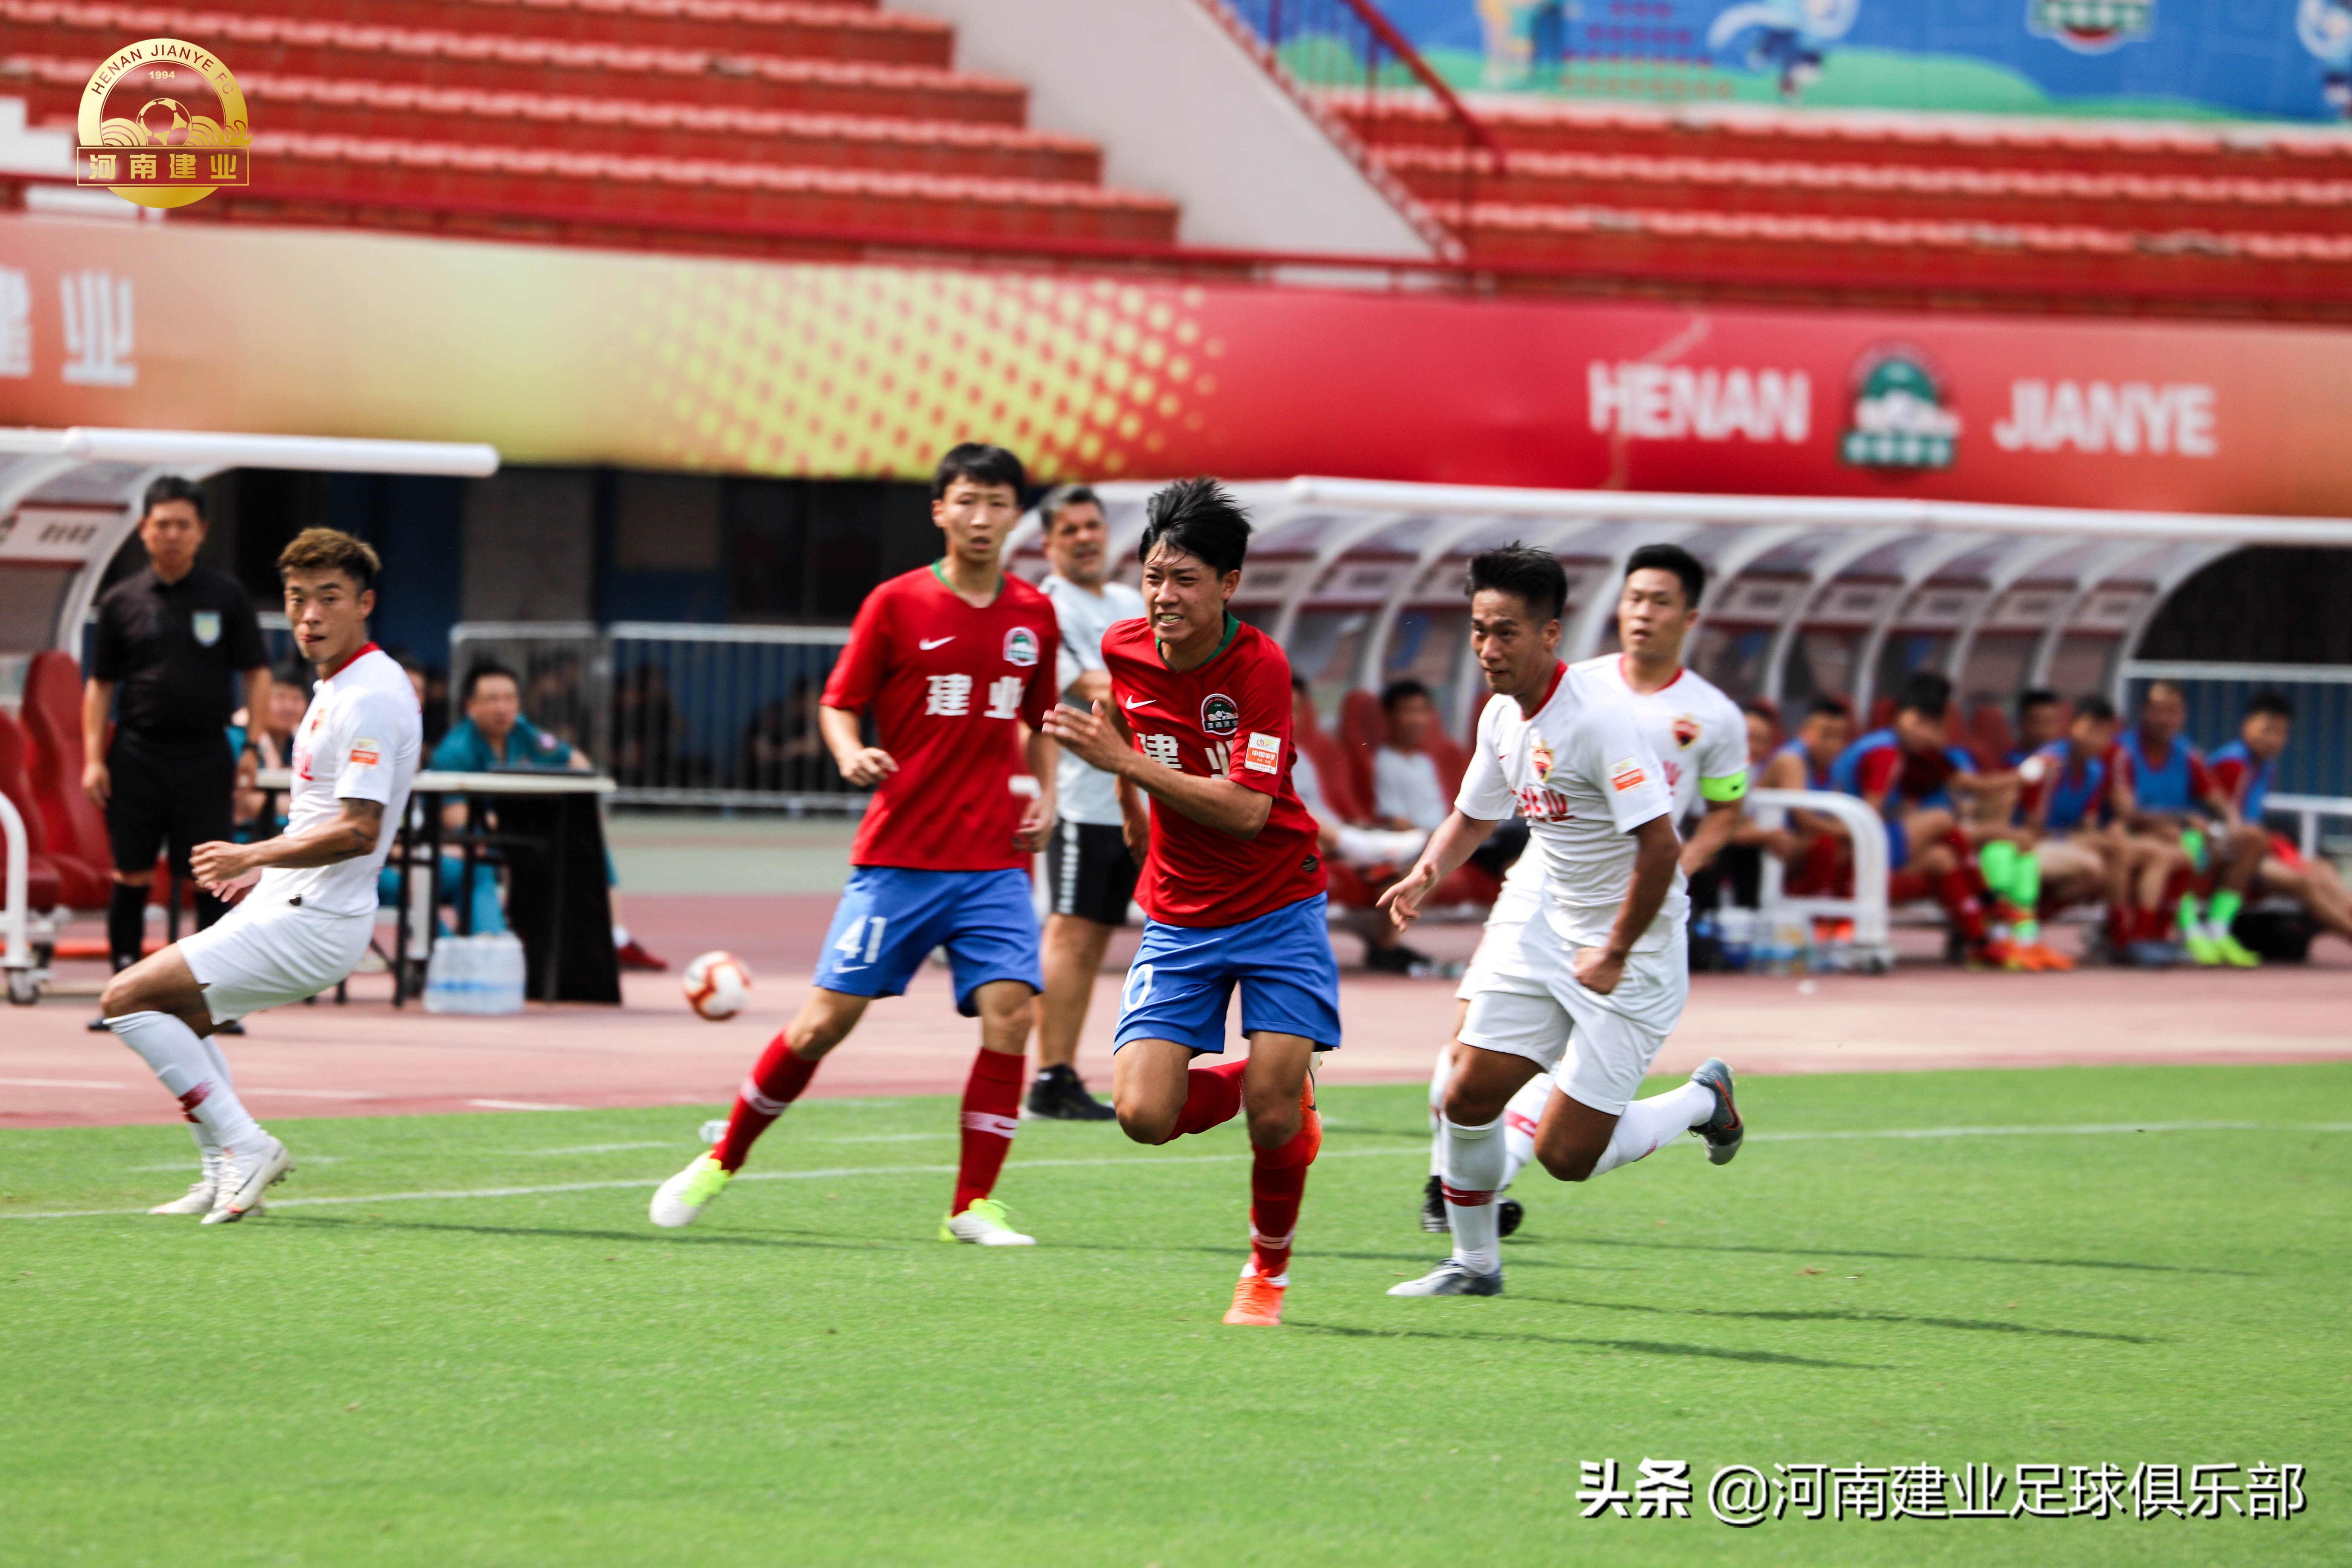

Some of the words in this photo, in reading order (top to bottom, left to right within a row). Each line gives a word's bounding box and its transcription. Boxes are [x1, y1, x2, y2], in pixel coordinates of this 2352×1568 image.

[1588, 360, 1810, 443] HENAN
[1993, 378, 2217, 456] JIANYE
[925, 674, 1025, 720] 建业
[834, 915, 887, 963] 41
